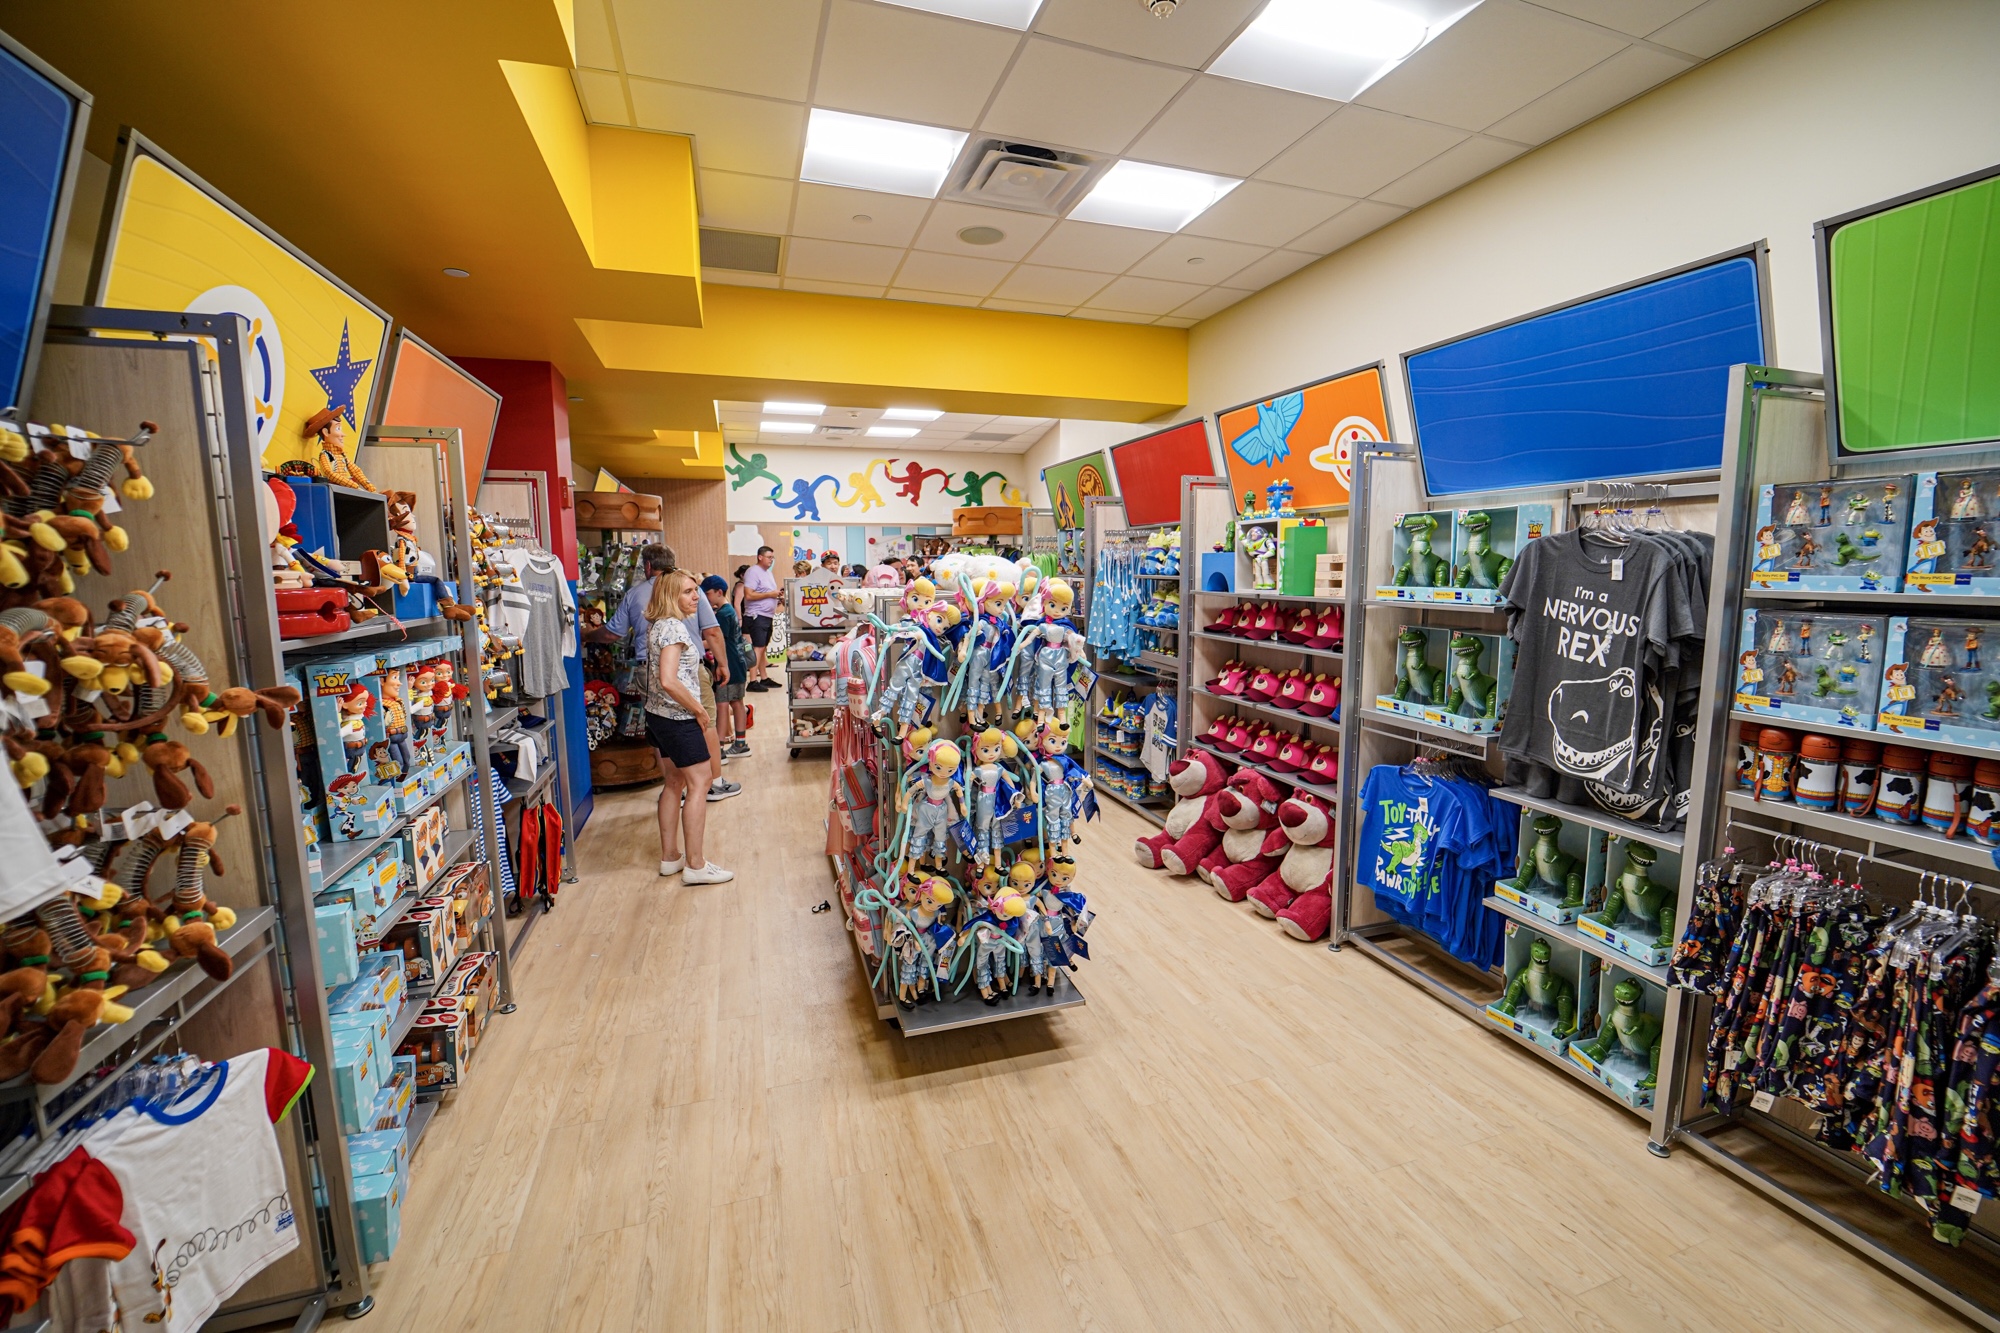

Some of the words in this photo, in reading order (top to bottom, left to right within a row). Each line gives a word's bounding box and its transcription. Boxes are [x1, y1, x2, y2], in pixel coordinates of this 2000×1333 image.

[1528, 523, 1543, 533] TOY
[800, 585, 829, 599] TOY
[1574, 586, 1594, 600] I'm
[1599, 592, 1609, 603] a
[808, 604, 822, 617] 4
[1543, 597, 1640, 637] NERVOUS
[1557, 626, 1609, 668] REX
[313, 673, 351, 689] TOY
